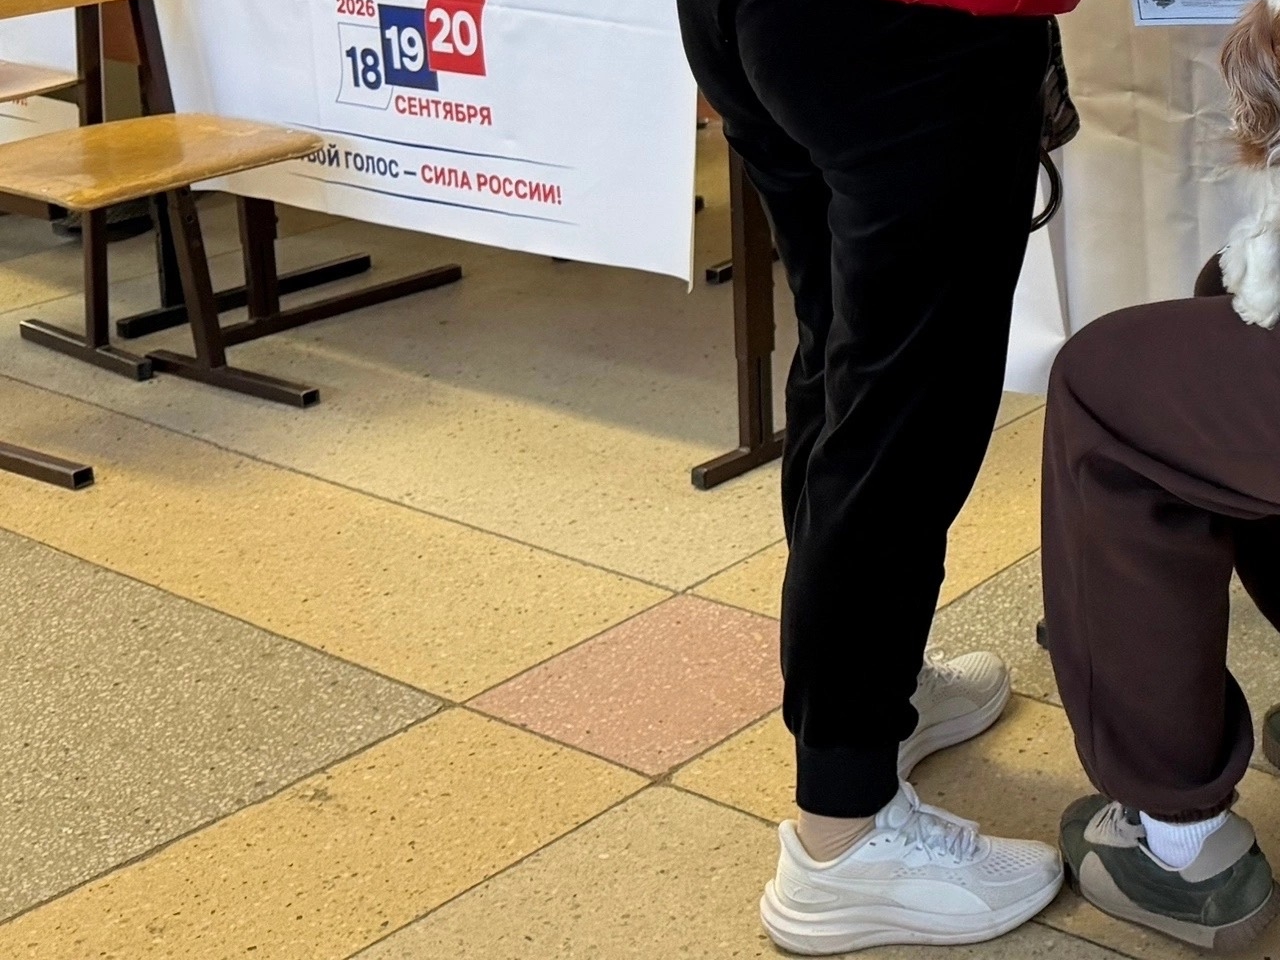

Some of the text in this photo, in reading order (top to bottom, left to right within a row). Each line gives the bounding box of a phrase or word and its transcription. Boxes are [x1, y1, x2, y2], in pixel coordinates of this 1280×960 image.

[345, 7, 478, 90] 18 19 20
[394, 94, 493, 126] СЕНТЯБРЯ
[344, 150, 400, 178] ГОЛОС
[420, 164, 472, 190] СИЛА
[476, 173, 562, 205] РОССИИ!
